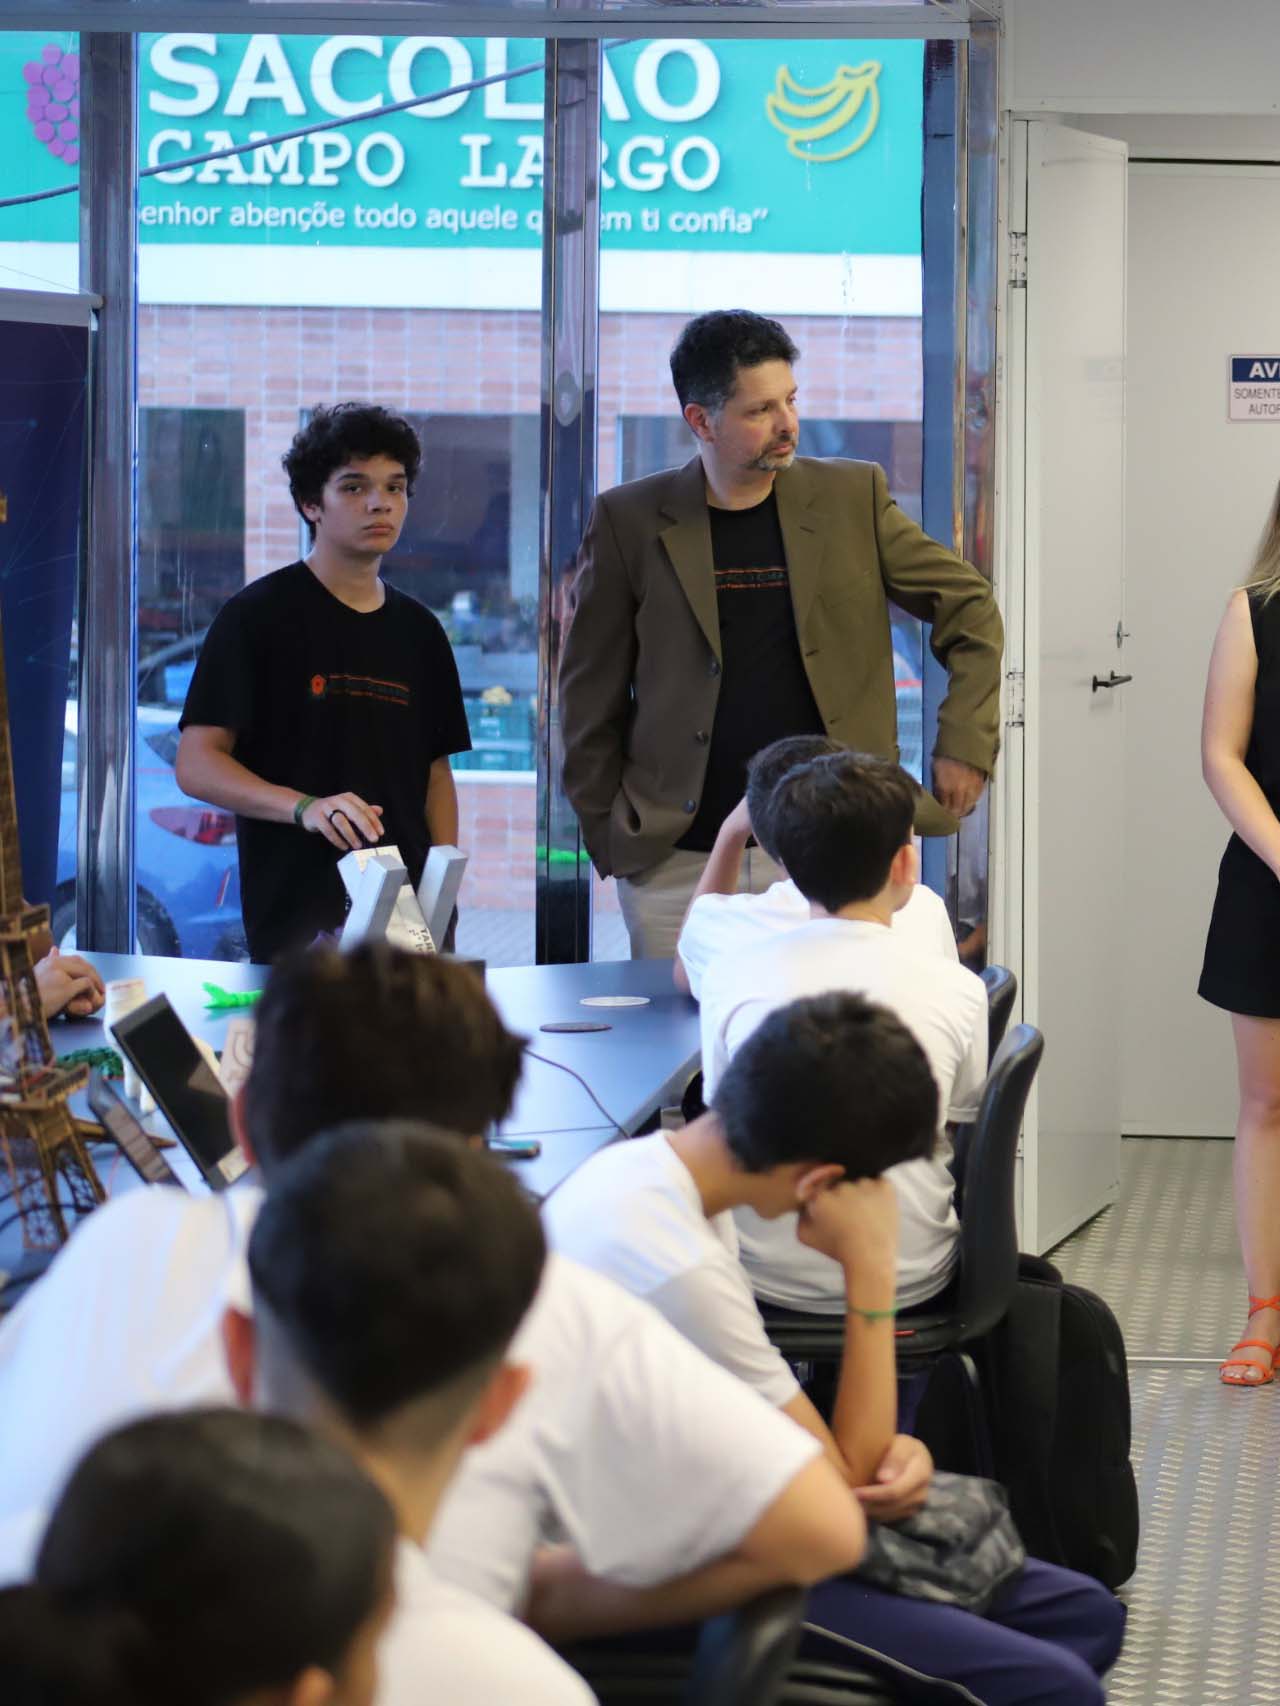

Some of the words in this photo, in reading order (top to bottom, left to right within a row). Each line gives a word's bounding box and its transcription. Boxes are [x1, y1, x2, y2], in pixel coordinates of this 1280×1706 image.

[148, 129, 405, 187] CAMPO
[140, 200, 222, 226] enhor
[354, 202, 417, 229] todo
[425, 203, 518, 235] aquele
[641, 207, 660, 232] ti
